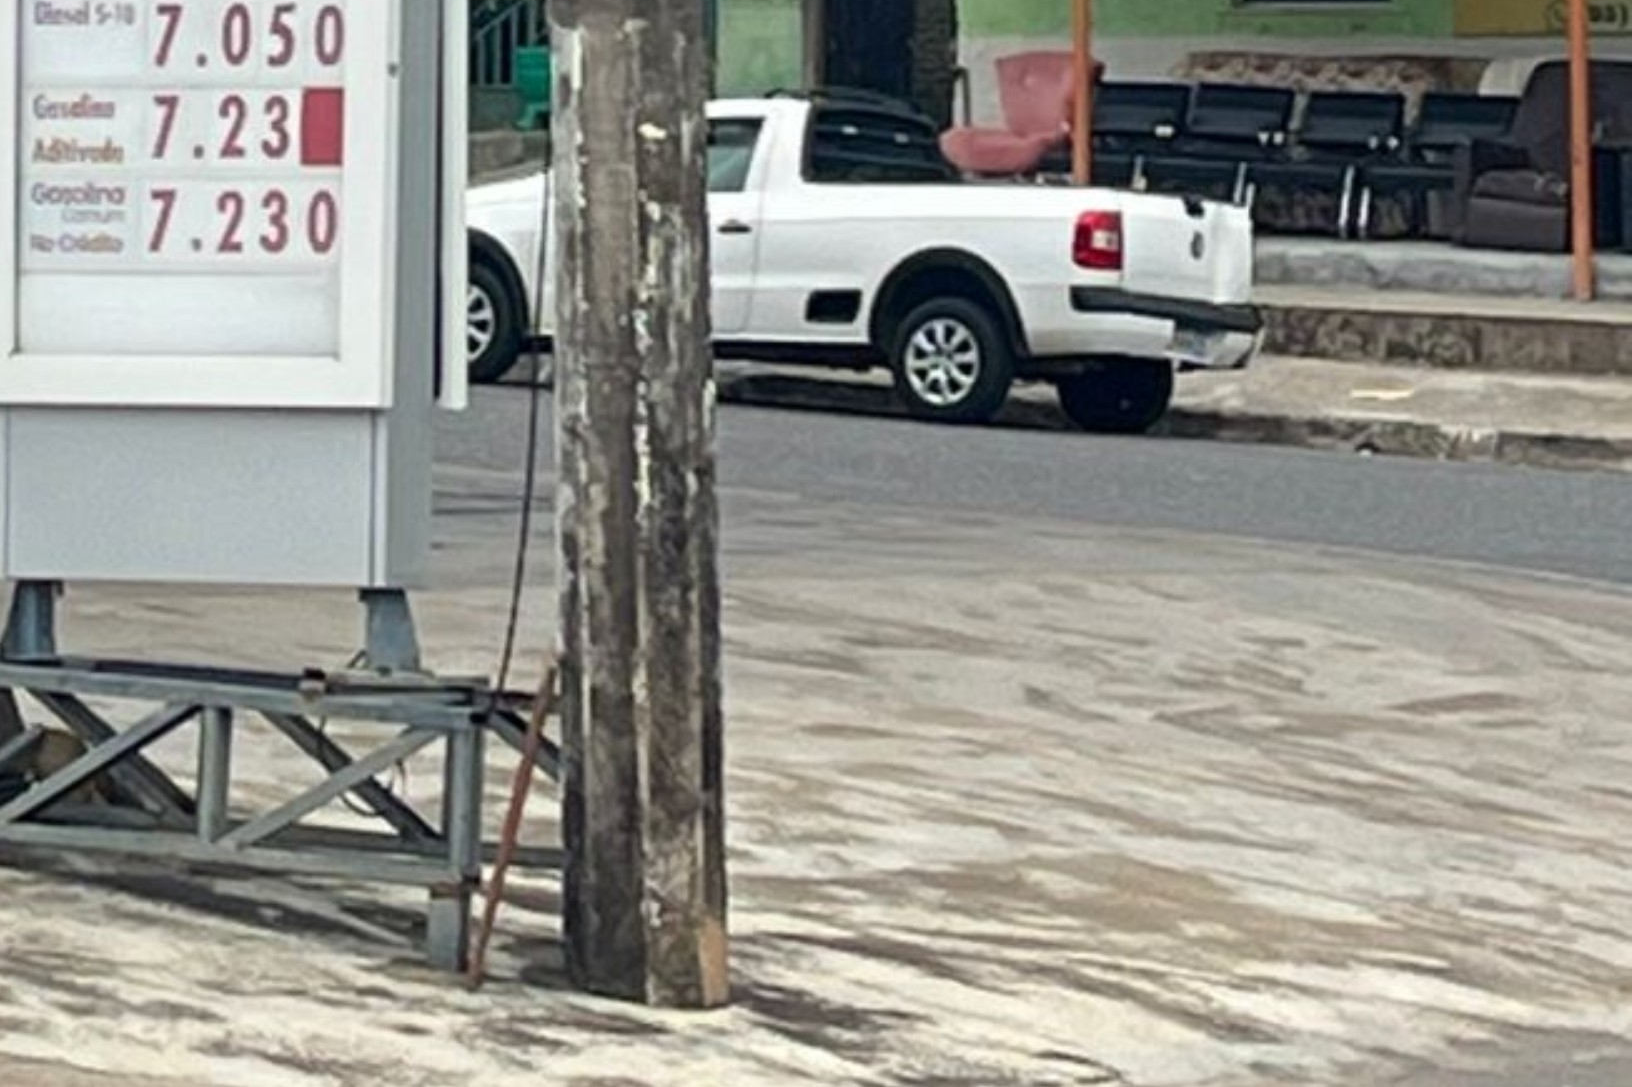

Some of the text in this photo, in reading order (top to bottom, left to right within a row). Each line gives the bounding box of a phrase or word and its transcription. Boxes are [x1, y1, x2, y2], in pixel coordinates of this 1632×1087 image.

[34, 1, 90, 25] Diesel
[154, 3, 345, 67] 7.050
[32, 93, 116, 119] Gasolina
[31, 182, 126, 205] Gasolina
[148, 188, 338, 254] 7.230
